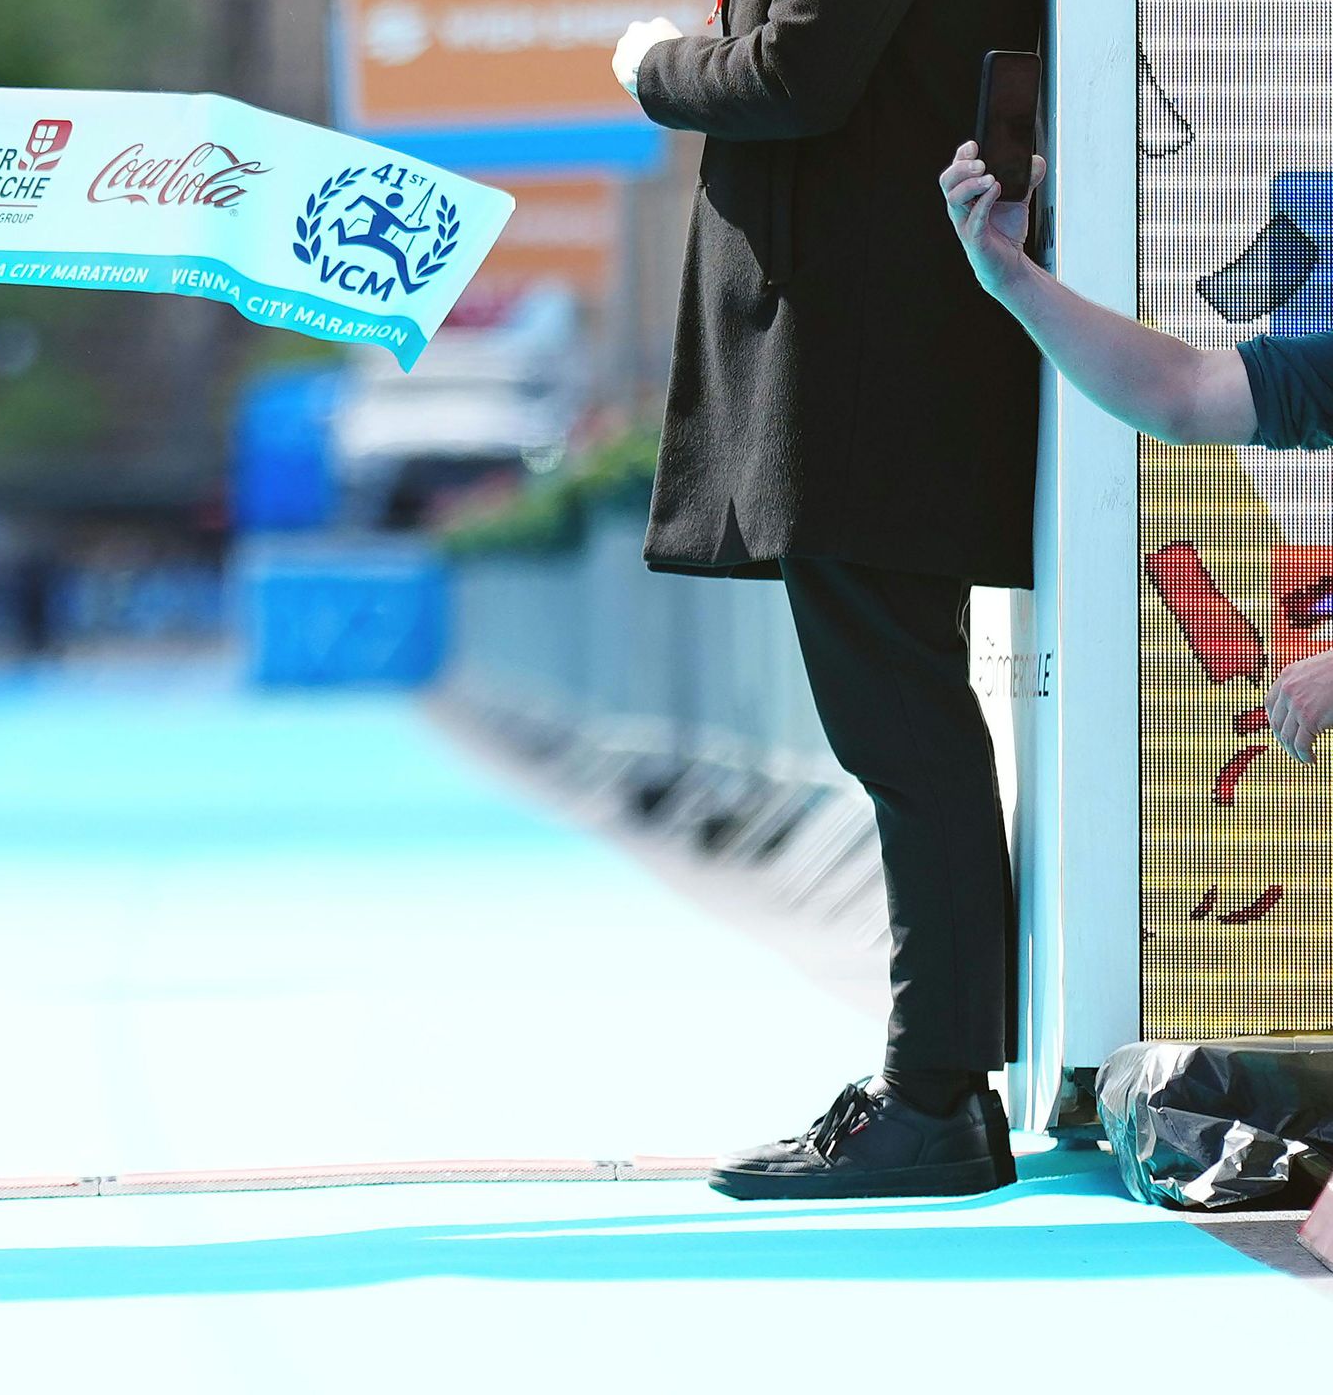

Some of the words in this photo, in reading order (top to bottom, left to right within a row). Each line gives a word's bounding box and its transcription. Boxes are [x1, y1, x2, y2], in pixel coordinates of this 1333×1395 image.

[9, 262, 51, 280] CITY
[51, 264, 149, 283] MARATHON
[319, 254, 397, 303] VCM
[171, 267, 241, 301] VIENNA
[246, 295, 292, 320] CITY
[294, 305, 408, 347] MARATHON
